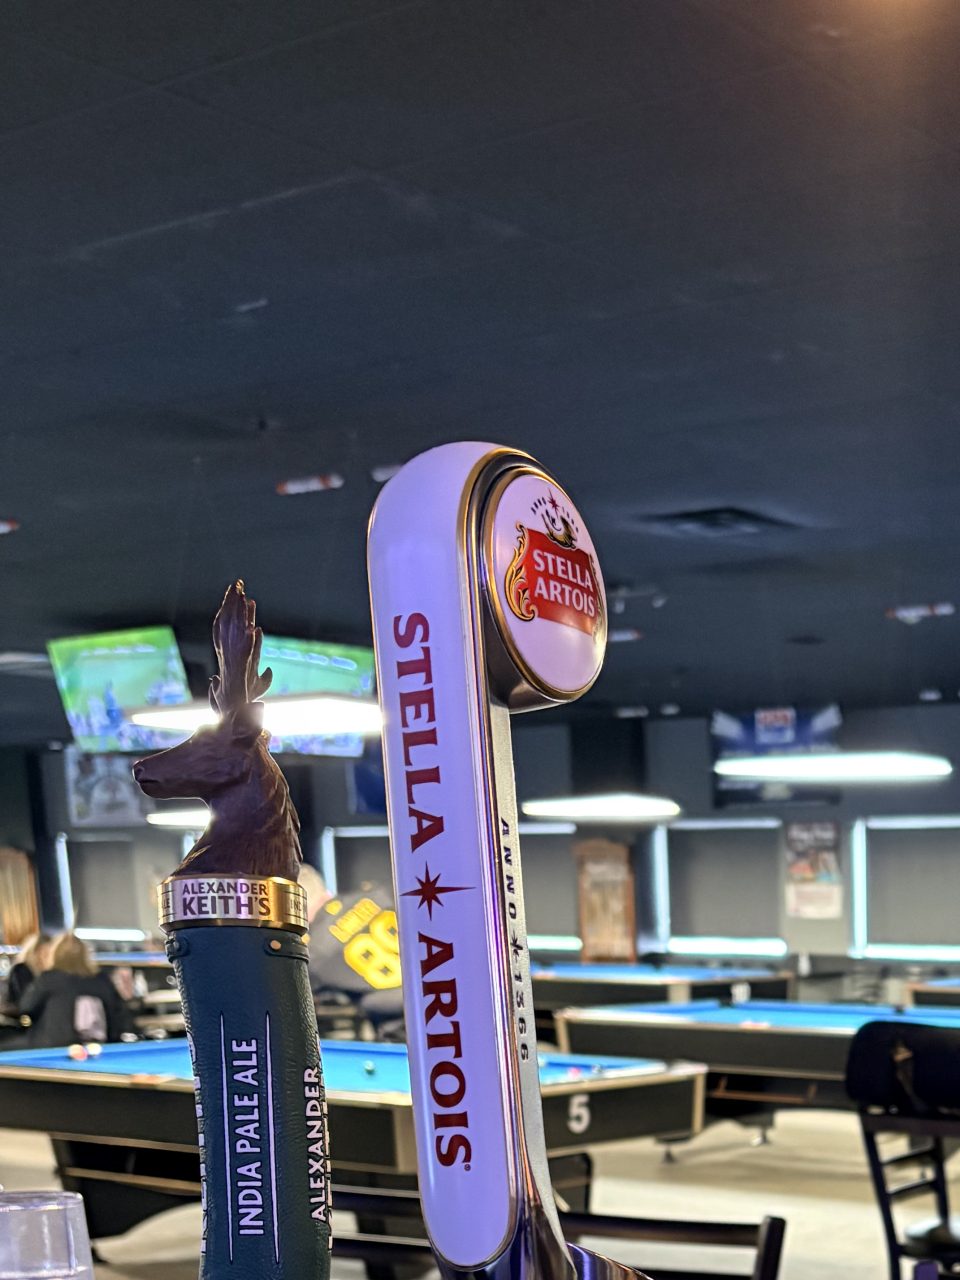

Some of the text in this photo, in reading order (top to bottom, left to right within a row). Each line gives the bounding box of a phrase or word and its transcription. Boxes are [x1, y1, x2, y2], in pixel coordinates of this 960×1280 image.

[531, 548, 594, 593] STELLA
[534, 577, 596, 618] ARTOIS
[182, 881, 268, 895] ALEXANDER
[182, 895, 272, 917] KEITH'S
[393, 611, 473, 1169] STELLA ARTOIS
[500, 817, 530, 1062] ANNO 1366
[567, 1094, 591, 1134] 5
[231, 1038, 265, 1236] INDIA PALE ALE
[303, 1067, 327, 1223] ALEXANDER
